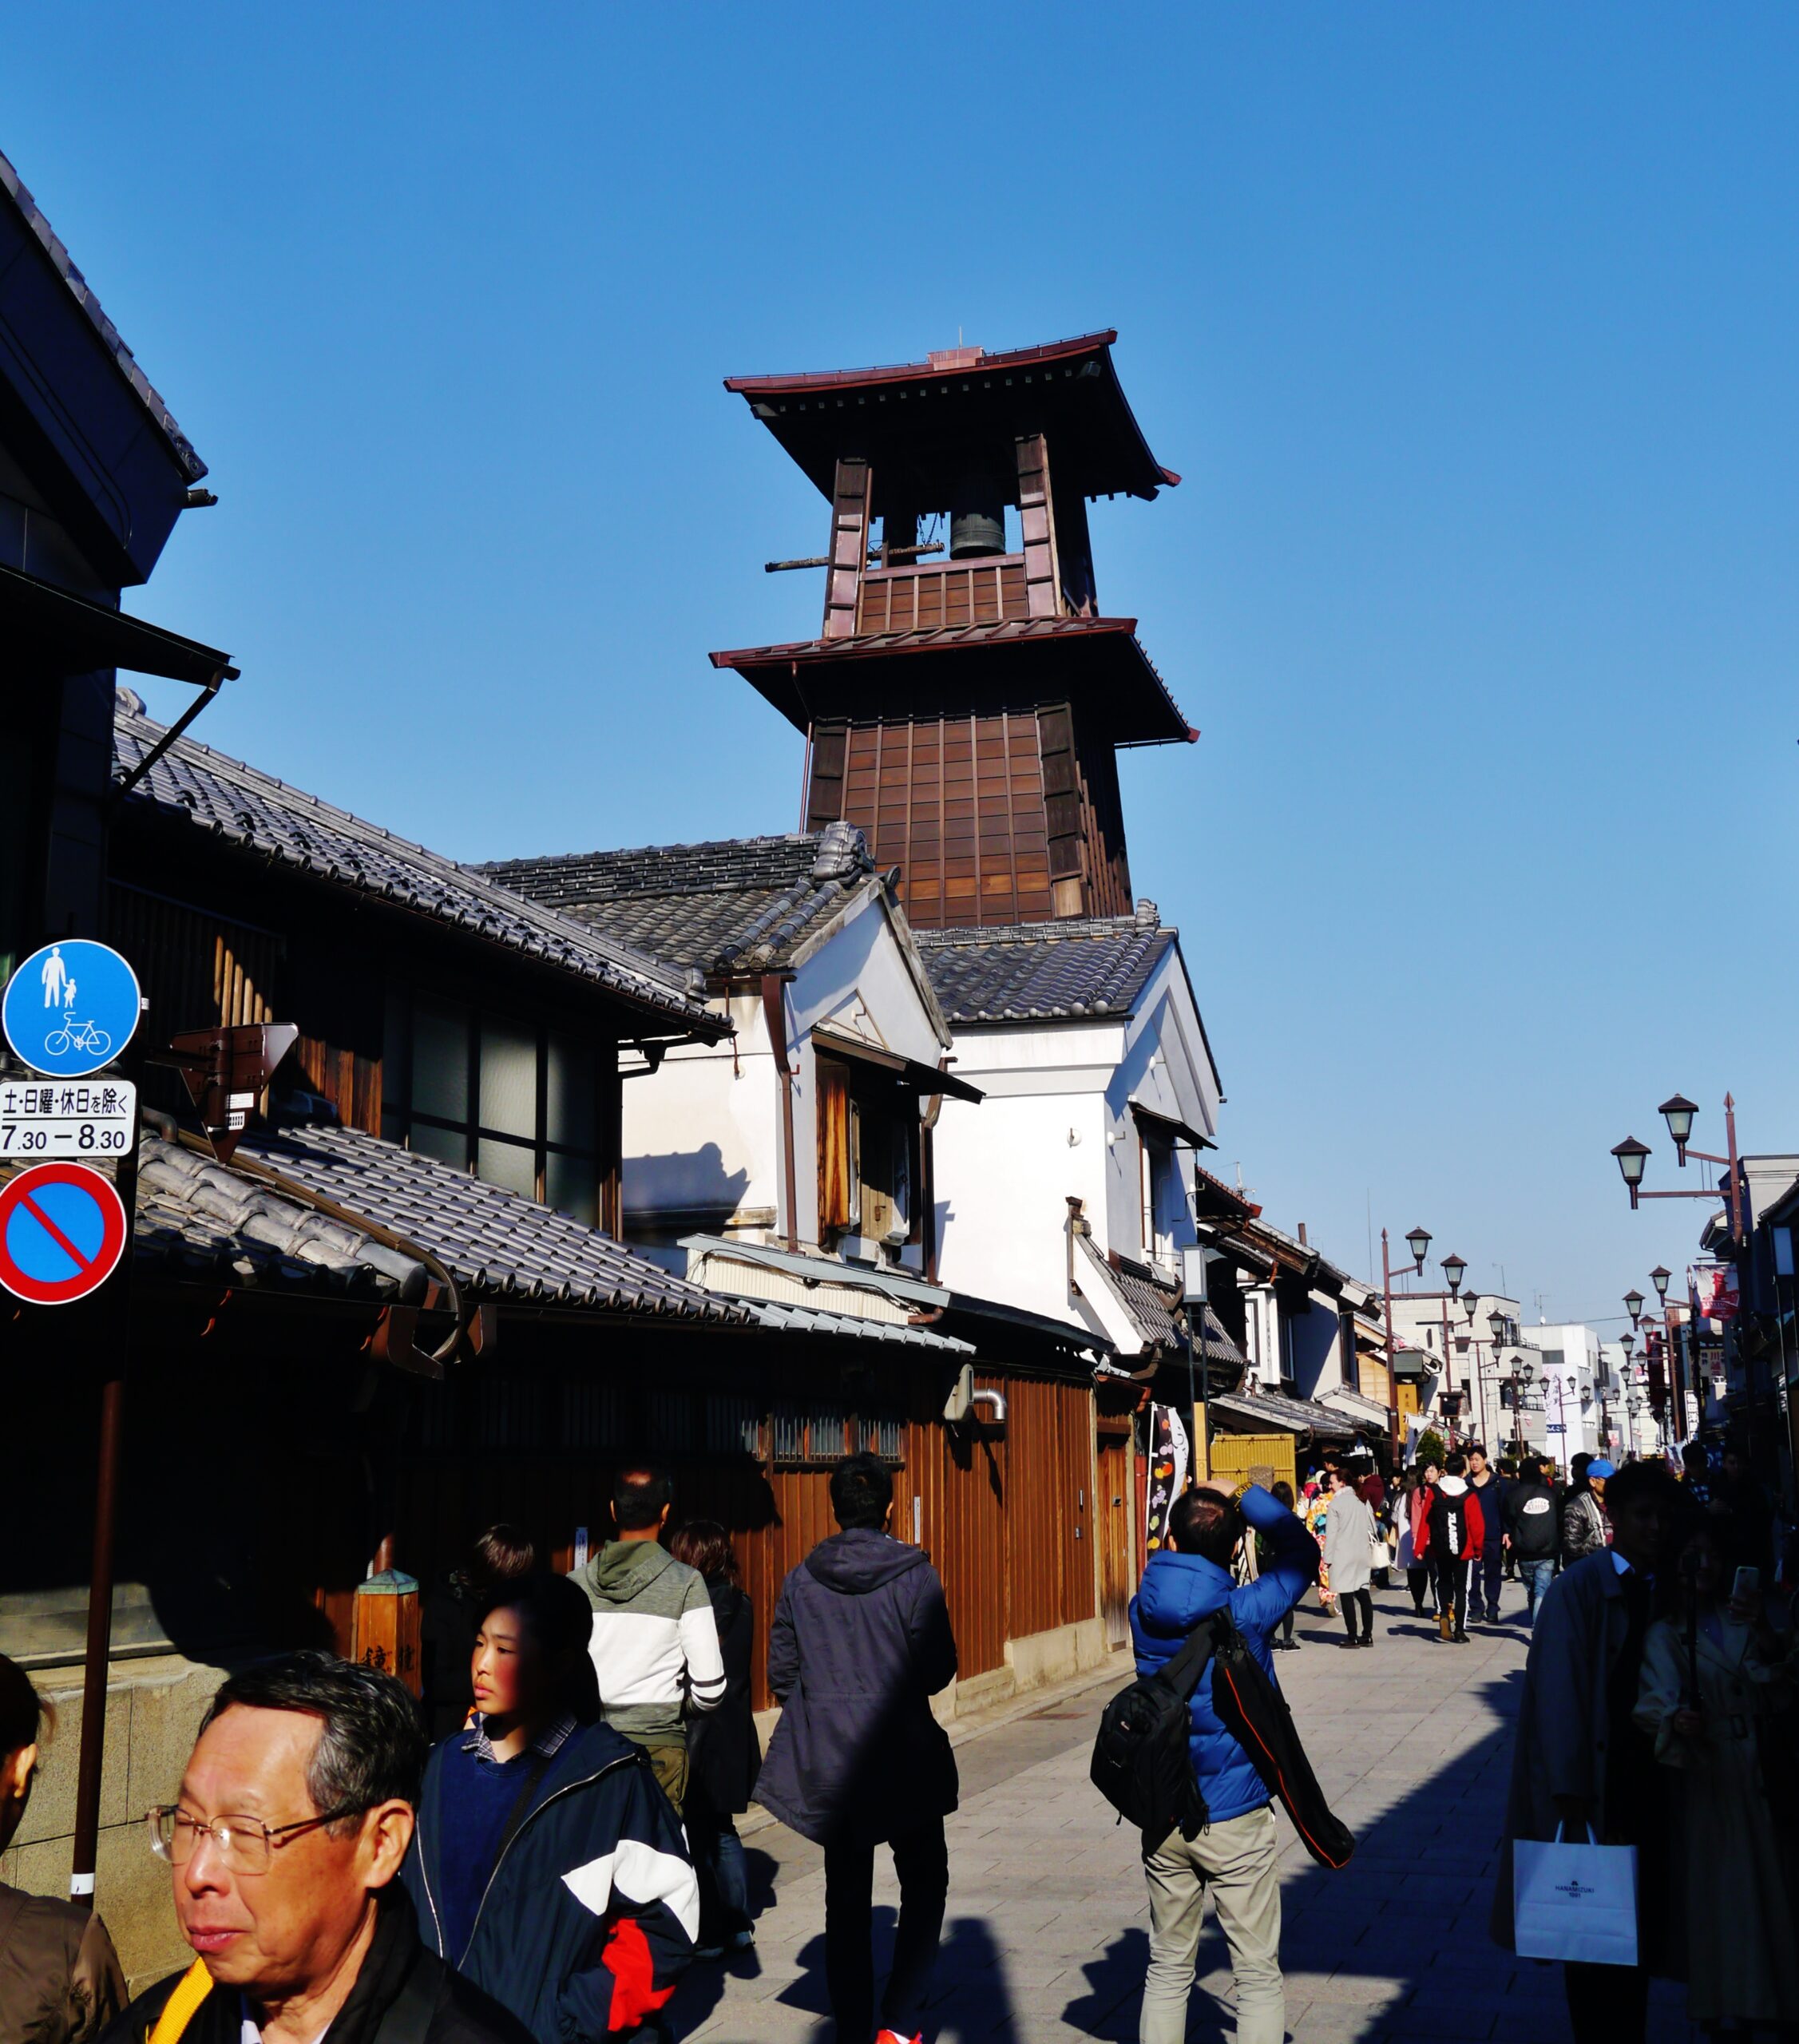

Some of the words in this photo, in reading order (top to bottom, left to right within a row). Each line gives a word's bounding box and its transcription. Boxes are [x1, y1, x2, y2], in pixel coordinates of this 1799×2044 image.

[2, 1088, 128, 1114] 土・日曜・休日を除く
